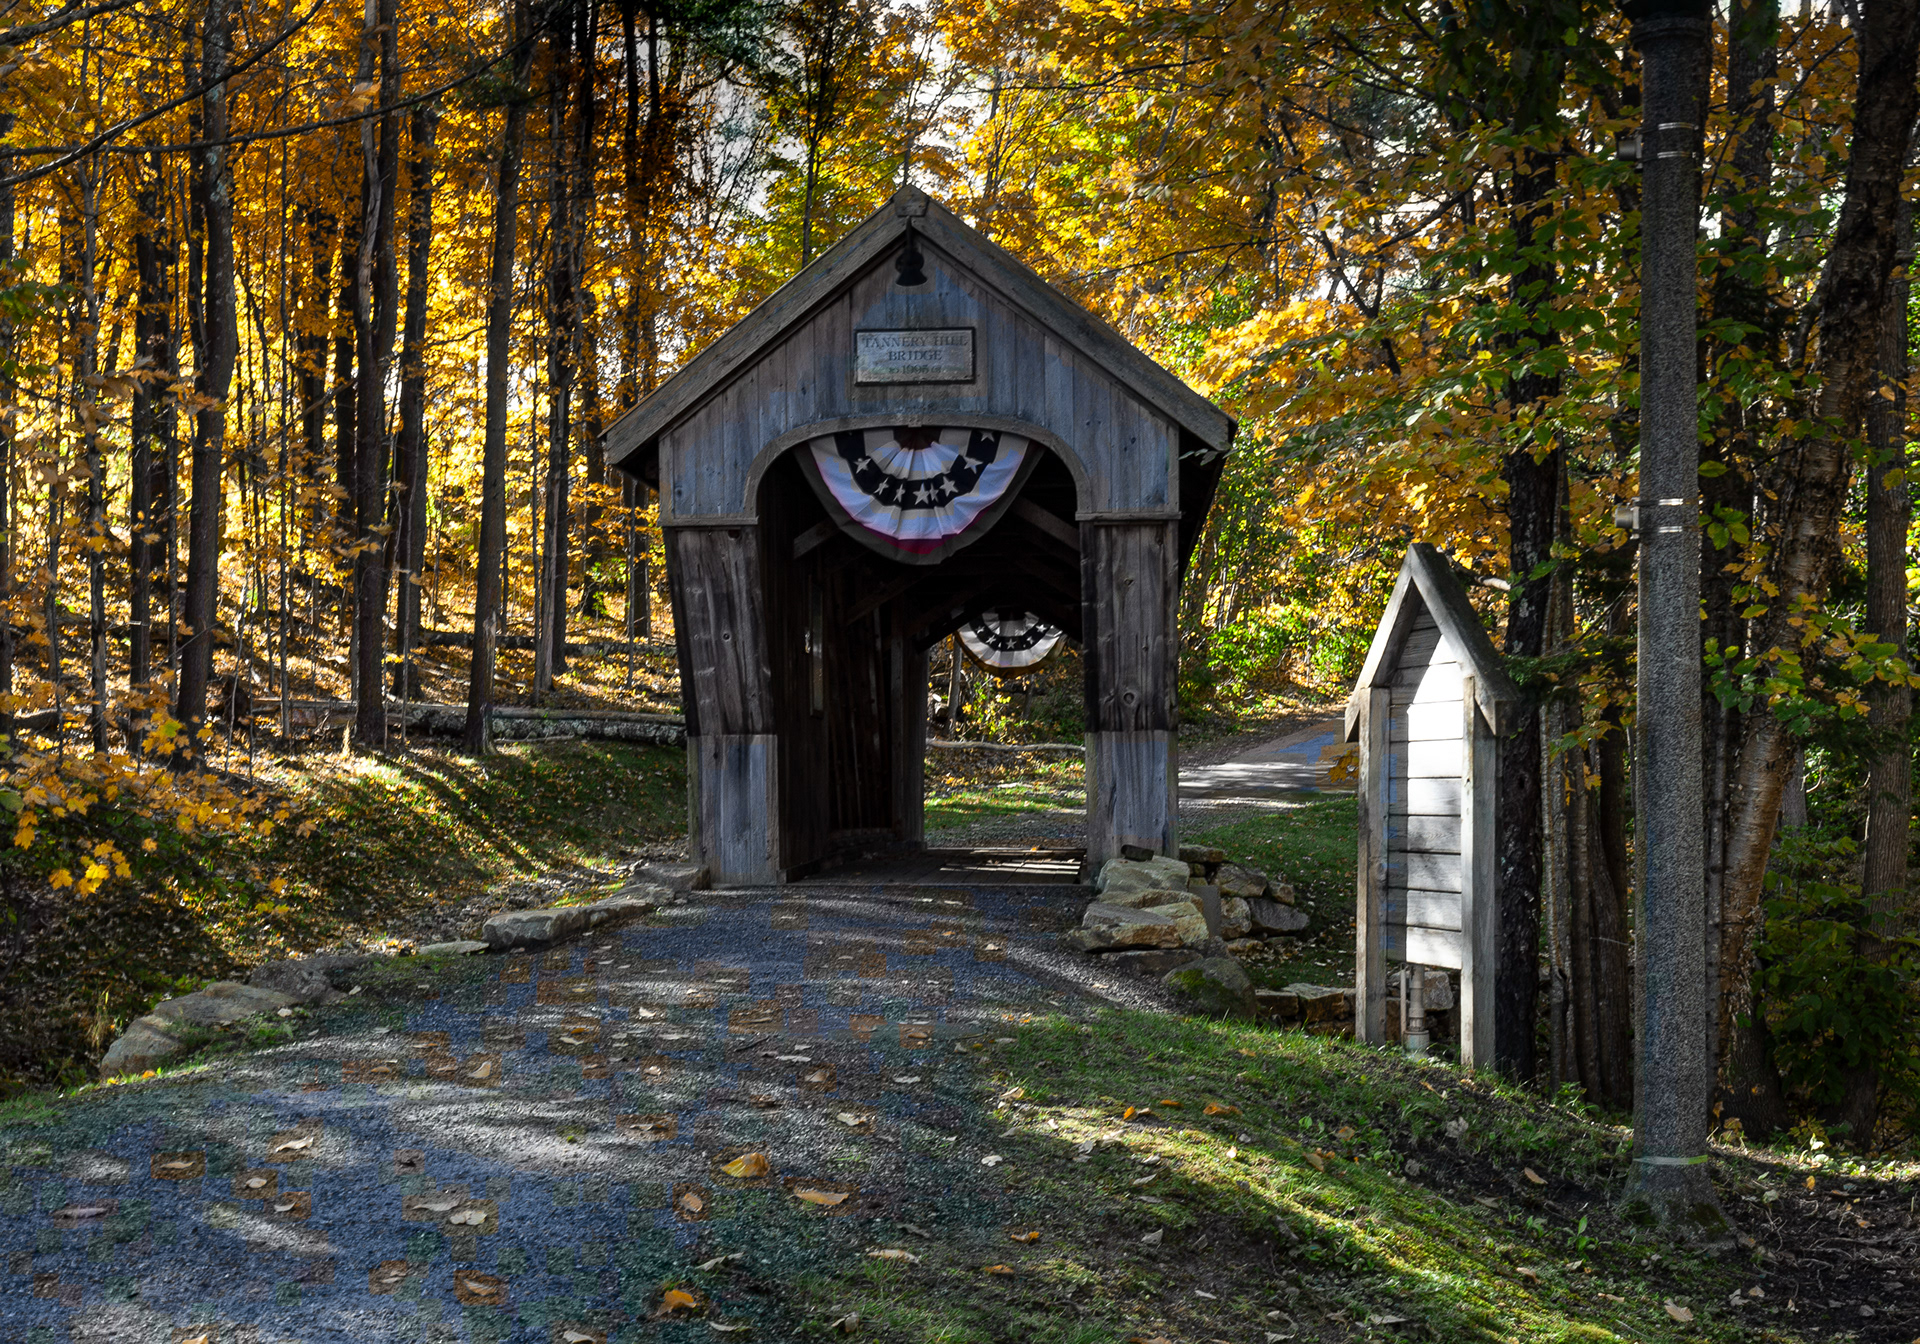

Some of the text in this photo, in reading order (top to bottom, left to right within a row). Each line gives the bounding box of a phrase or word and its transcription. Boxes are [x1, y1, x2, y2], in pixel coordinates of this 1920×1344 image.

[863, 335, 968, 348] TANNERY HILL
[888, 350, 942, 361] BRIDGE
